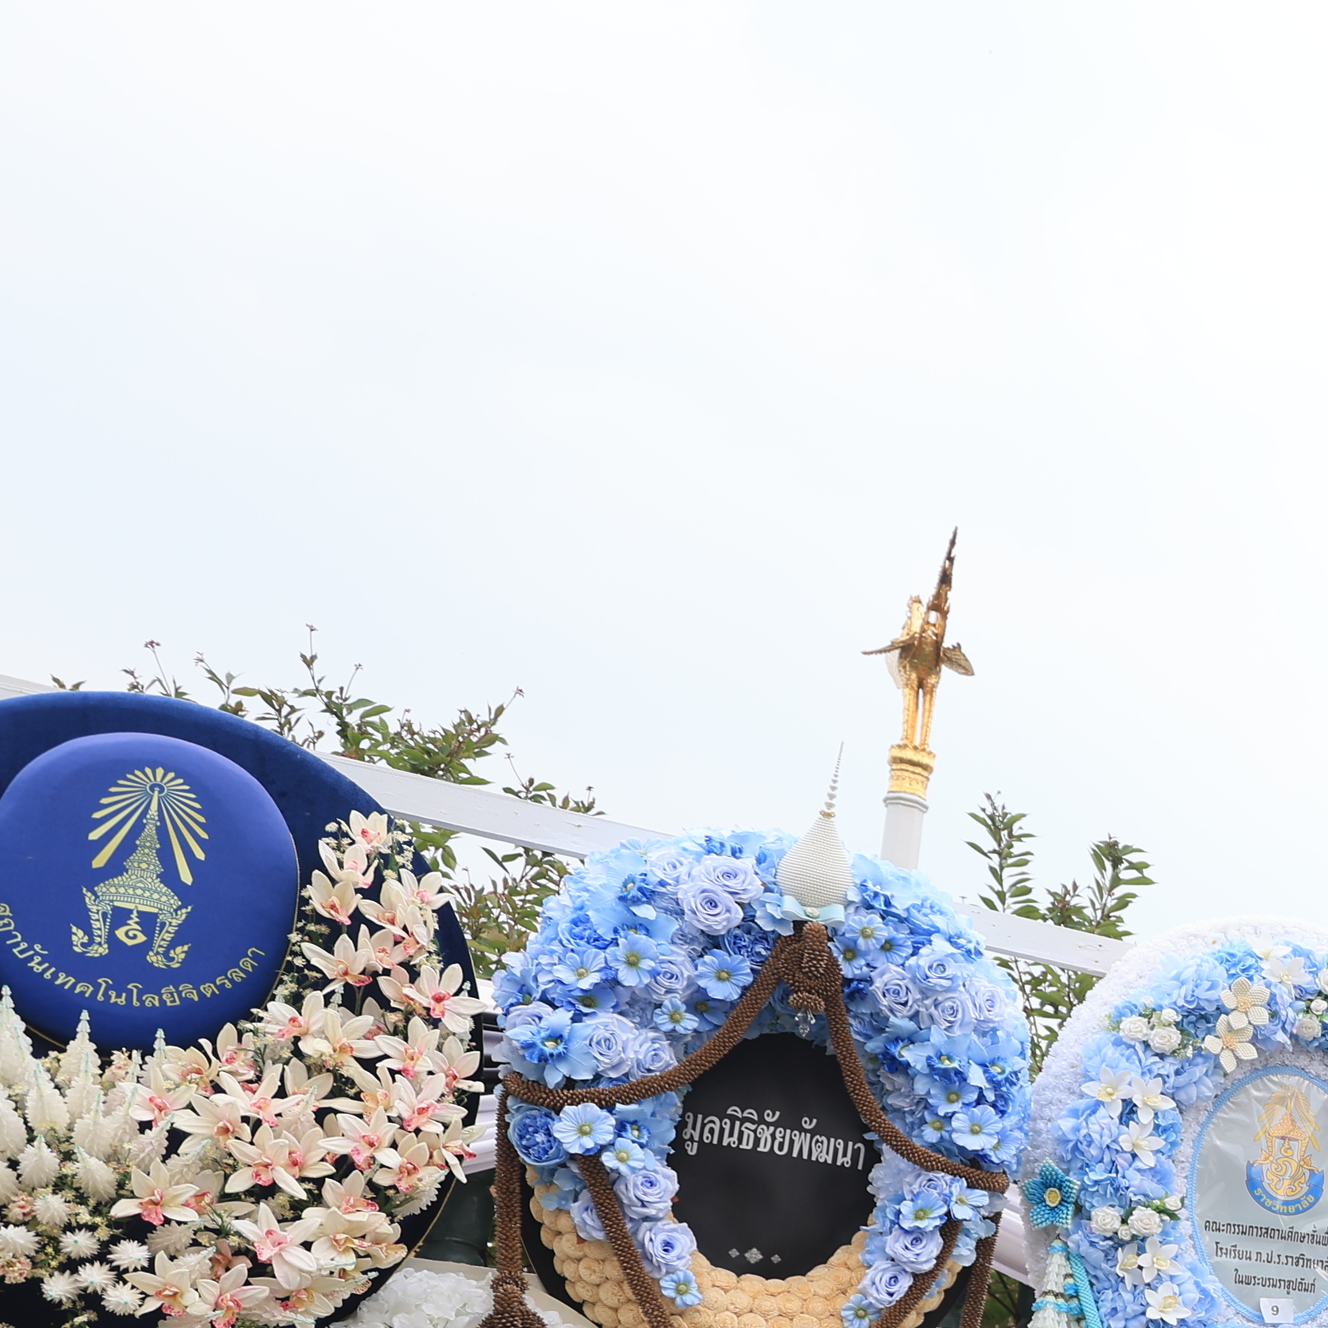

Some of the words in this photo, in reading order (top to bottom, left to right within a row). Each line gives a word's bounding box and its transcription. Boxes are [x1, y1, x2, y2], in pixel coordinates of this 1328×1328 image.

[681, 1105, 867, 1171] มูลนิธิชัยพัฒนา
[1214, 1241, 1252, 1261] โรงเรียน
[1233, 1268, 1316, 1295] ในพระบรมราชูปถัมภ์
[1271, 1305, 1280, 1316] 9
